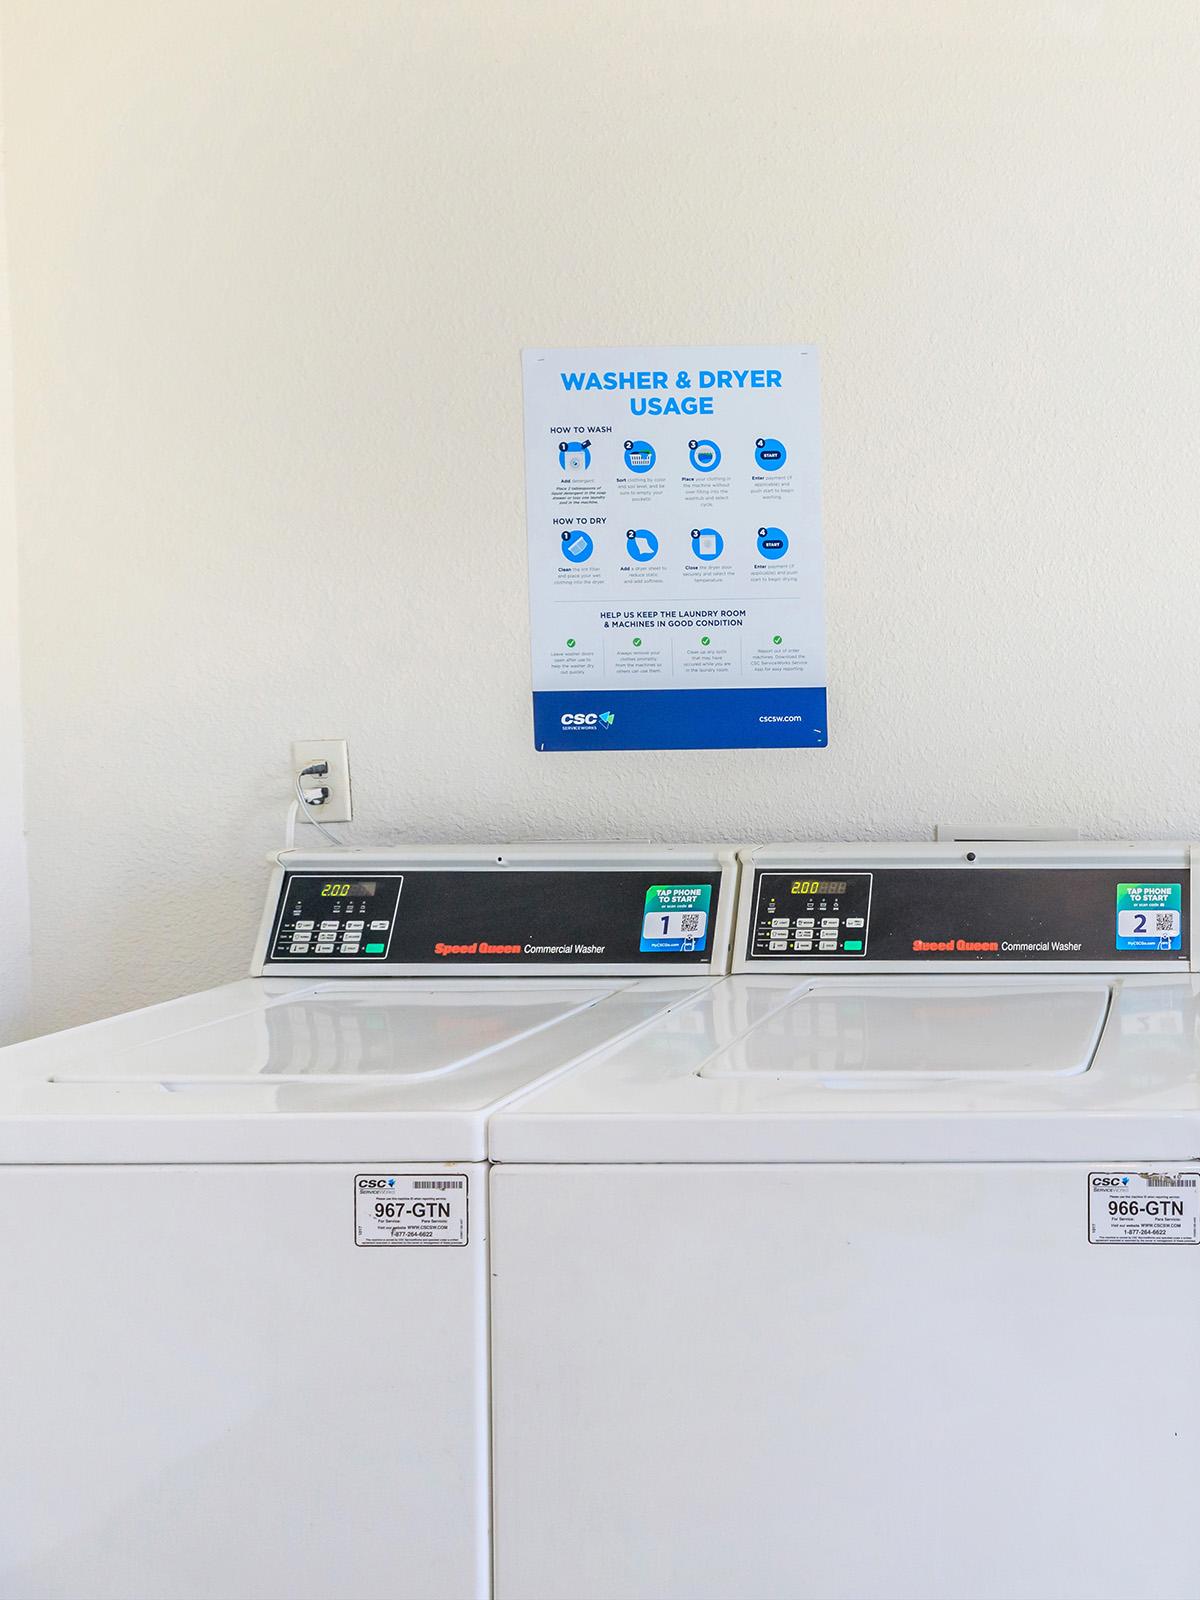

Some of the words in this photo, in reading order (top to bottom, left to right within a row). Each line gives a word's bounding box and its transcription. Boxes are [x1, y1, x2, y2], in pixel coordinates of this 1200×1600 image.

[560, 371, 668, 391] WASHER
[675, 371, 691, 389] &
[699, 370, 782, 388] DRYER
[630, 397, 714, 416] USAGE
[561, 713, 597, 725] CSC
[321, 884, 350, 896] 2.00
[791, 882, 820, 894] 2.00
[661, 916, 669, 934] 1
[1134, 914, 1146, 933] 2
[435, 943, 478, 956] Speed
[479, 942, 521, 953] Queen
[524, 944, 572, 954] Commercial
[574, 944, 605, 954] Washer
[956, 940, 998, 951] Queen
[1001, 941, 1050, 951] Commercial
[1051, 942, 1082, 951] Washer
[359, 1180, 386, 1188] CSC
[1092, 1177, 1120, 1186] CSC
[375, 1203, 450, 1218] 967-GTN
[1108, 1201, 1183, 1215] 966-GTN
